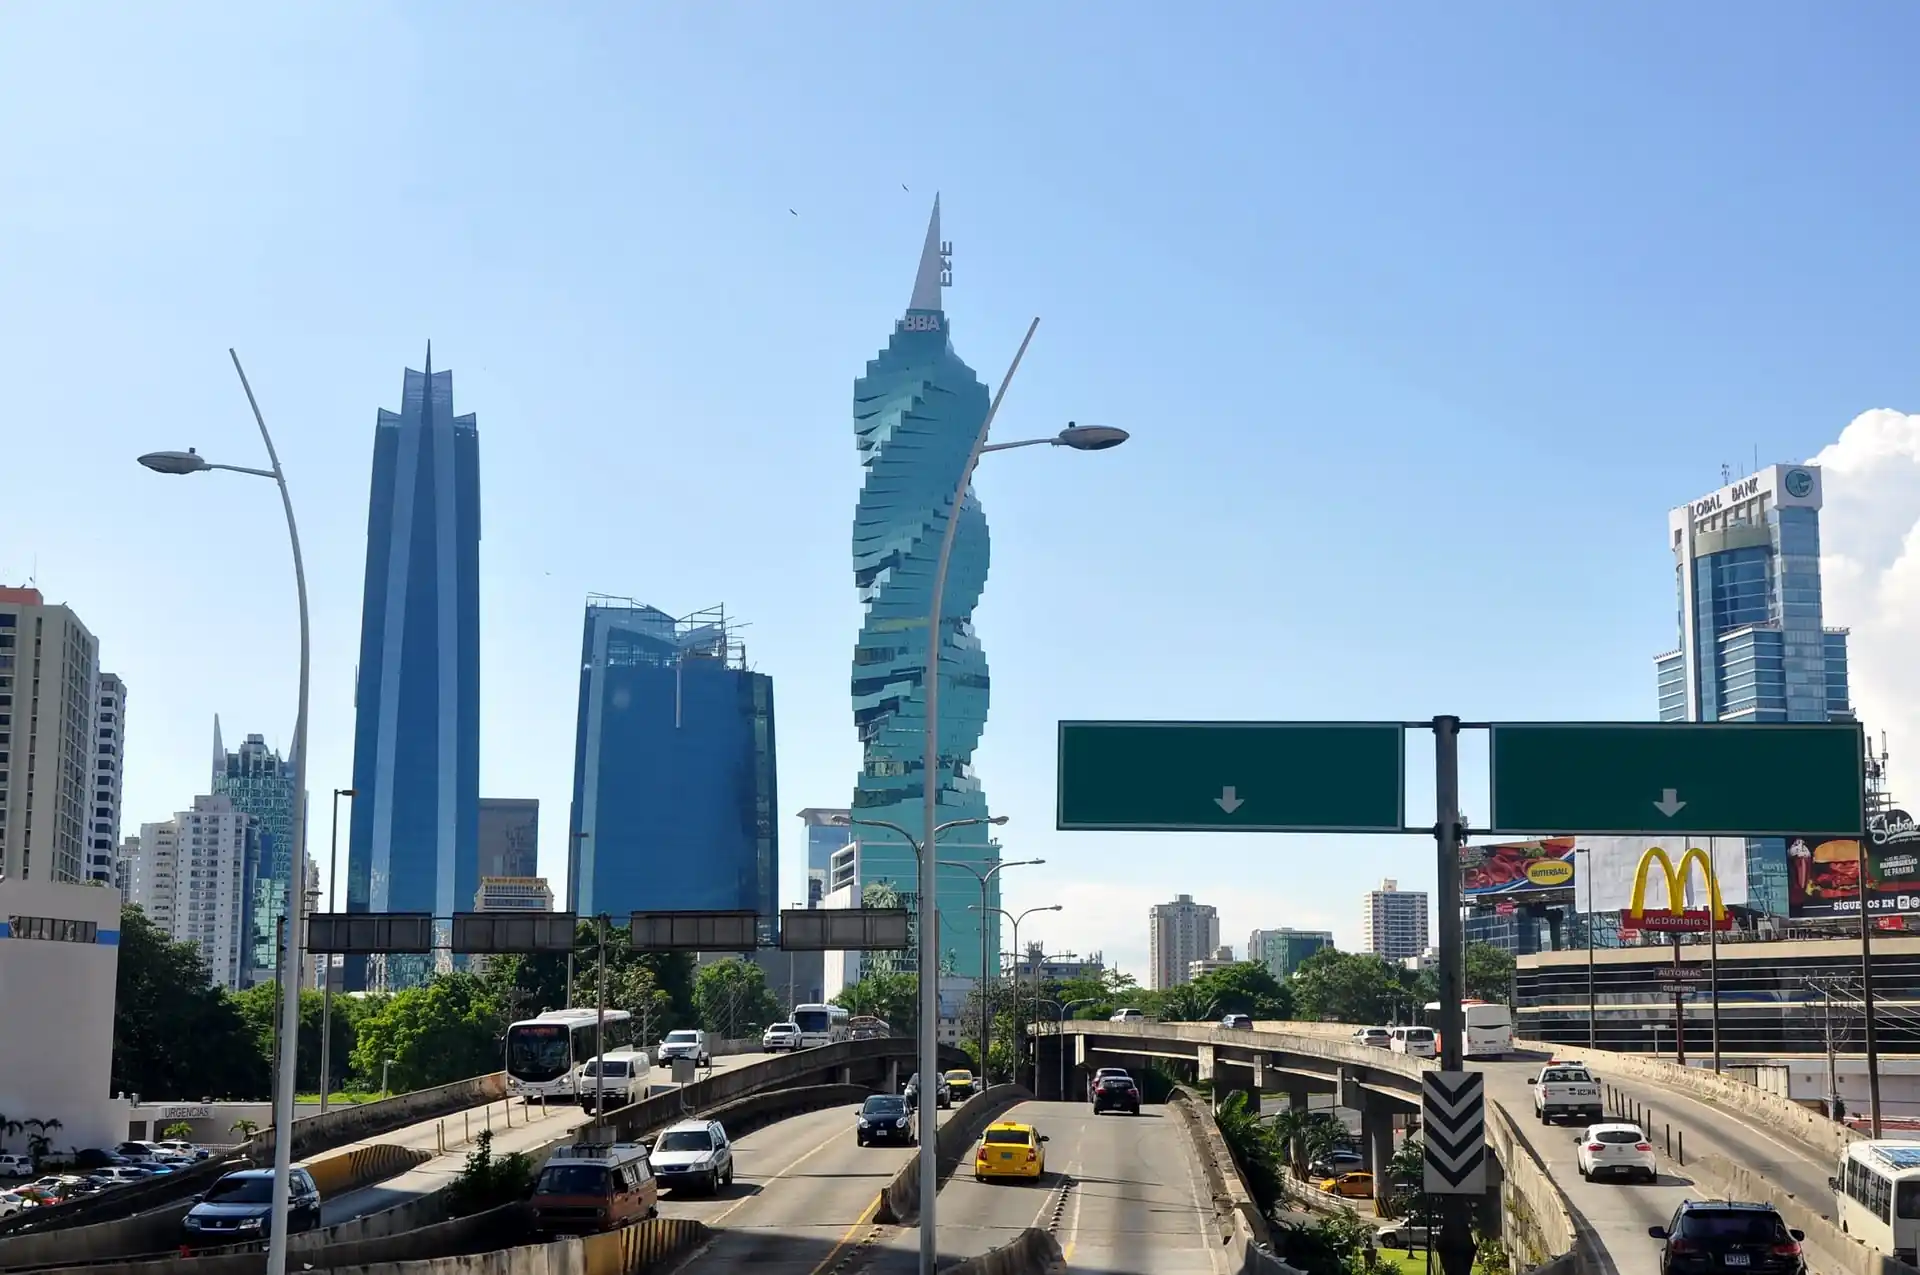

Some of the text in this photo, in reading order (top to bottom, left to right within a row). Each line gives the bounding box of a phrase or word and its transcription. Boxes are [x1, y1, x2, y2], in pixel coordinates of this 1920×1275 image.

[904, 315, 940, 332] BBA
[1691, 477, 1759, 520] LOBAL BANK
[1833, 899, 1880, 911] SÍGUEOS
[1881, 898, 1895, 908] EN
[1645, 917, 1709, 926] McDonald's
[1658, 969, 1701, 977] AUTOMAC
[164, 1107, 209, 1118] URGENCIAS
